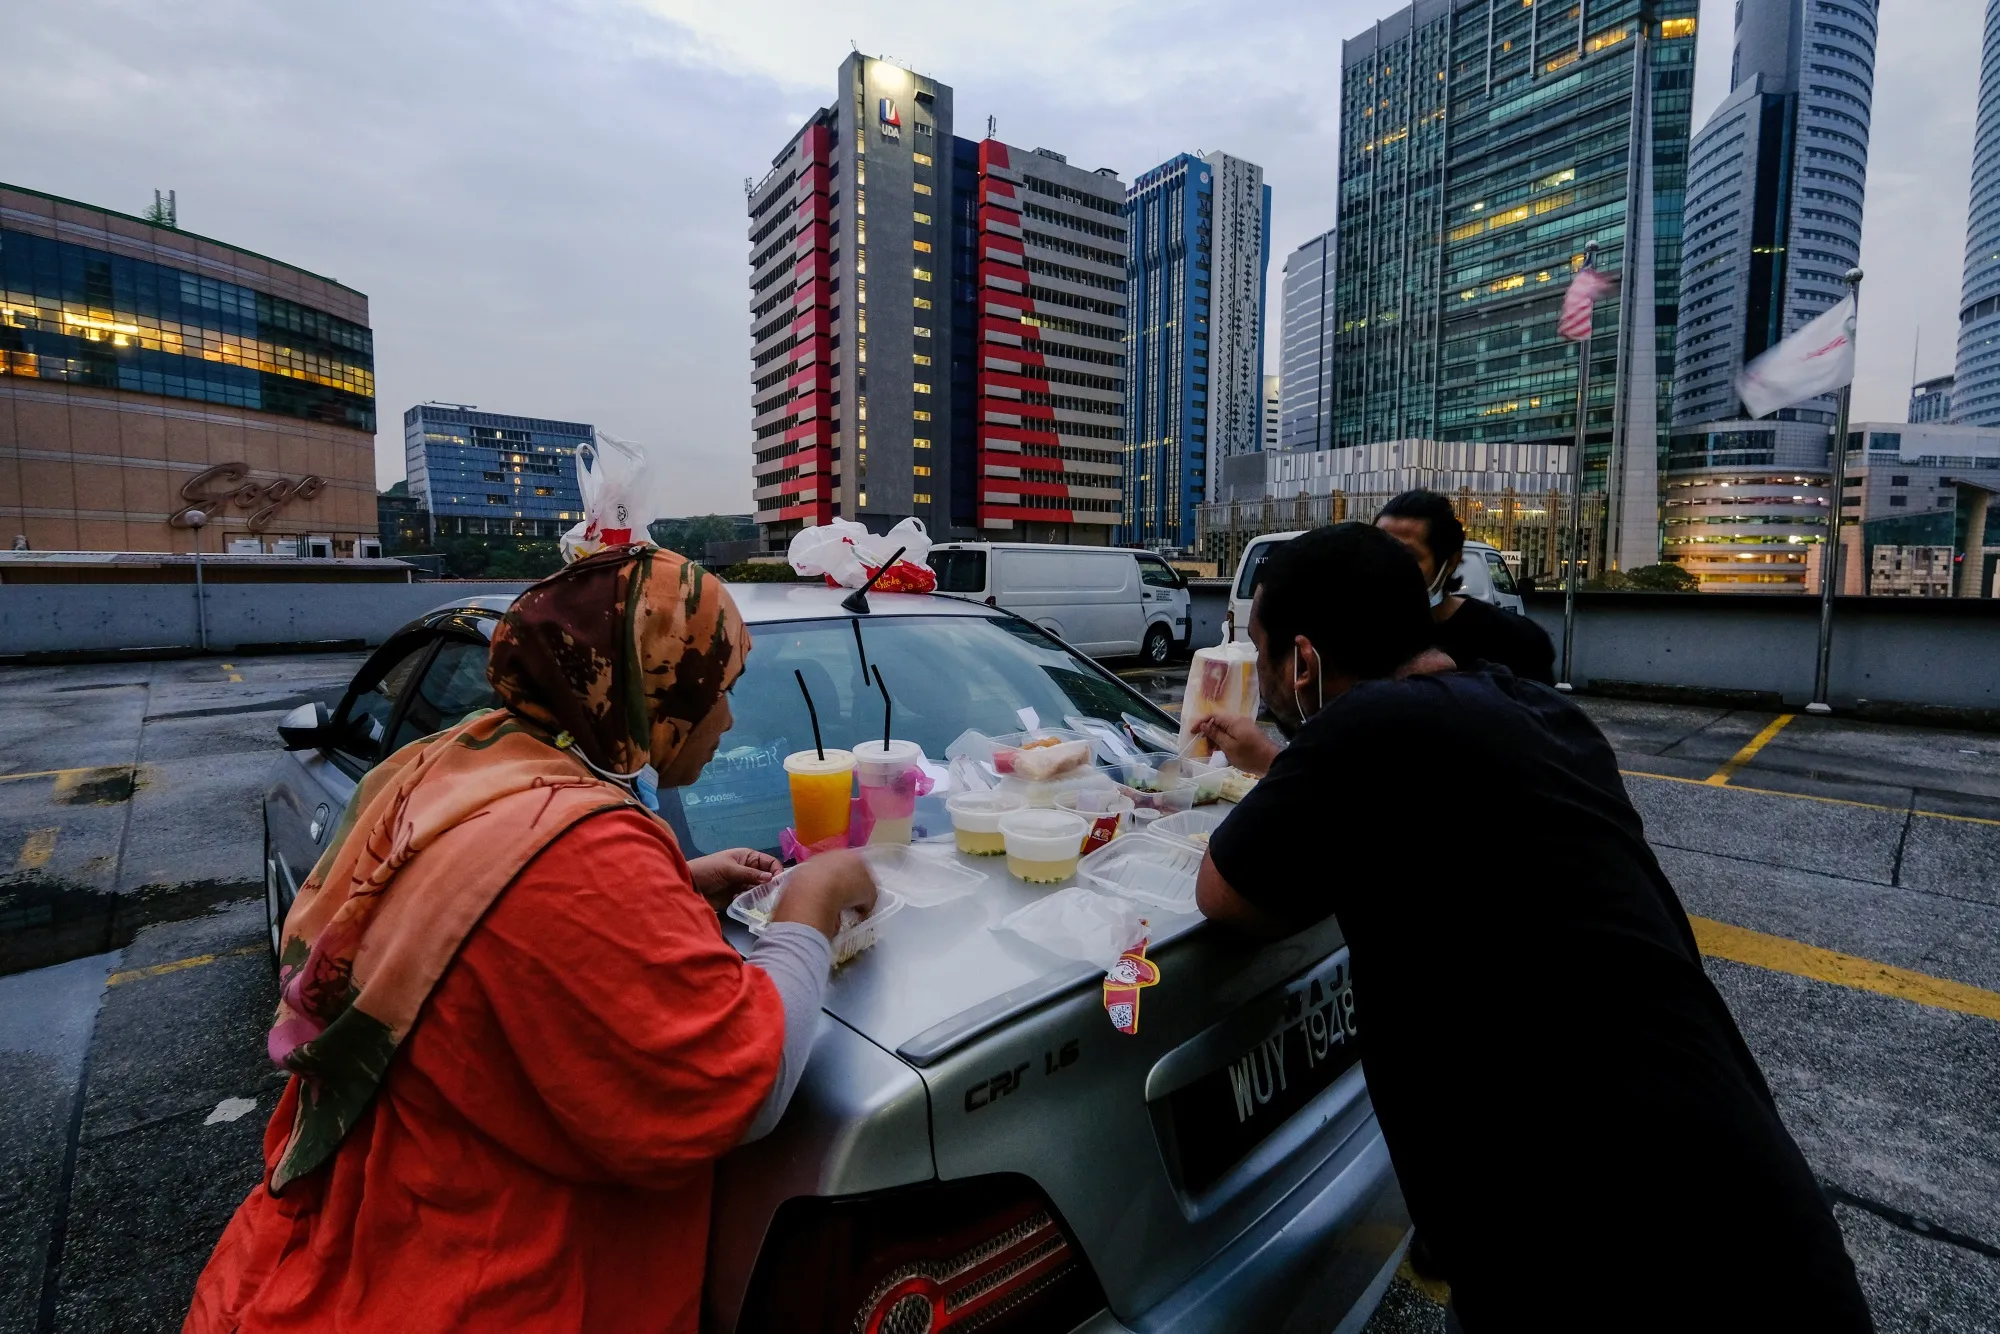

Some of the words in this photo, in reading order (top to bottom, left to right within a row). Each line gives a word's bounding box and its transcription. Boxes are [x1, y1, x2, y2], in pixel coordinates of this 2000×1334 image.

[881, 123, 900, 140] UDA
[1045, 1039, 1080, 1076] 1.6
[1228, 1031, 1287, 1123] WUY
[1300, 987, 1358, 1069] 1948
